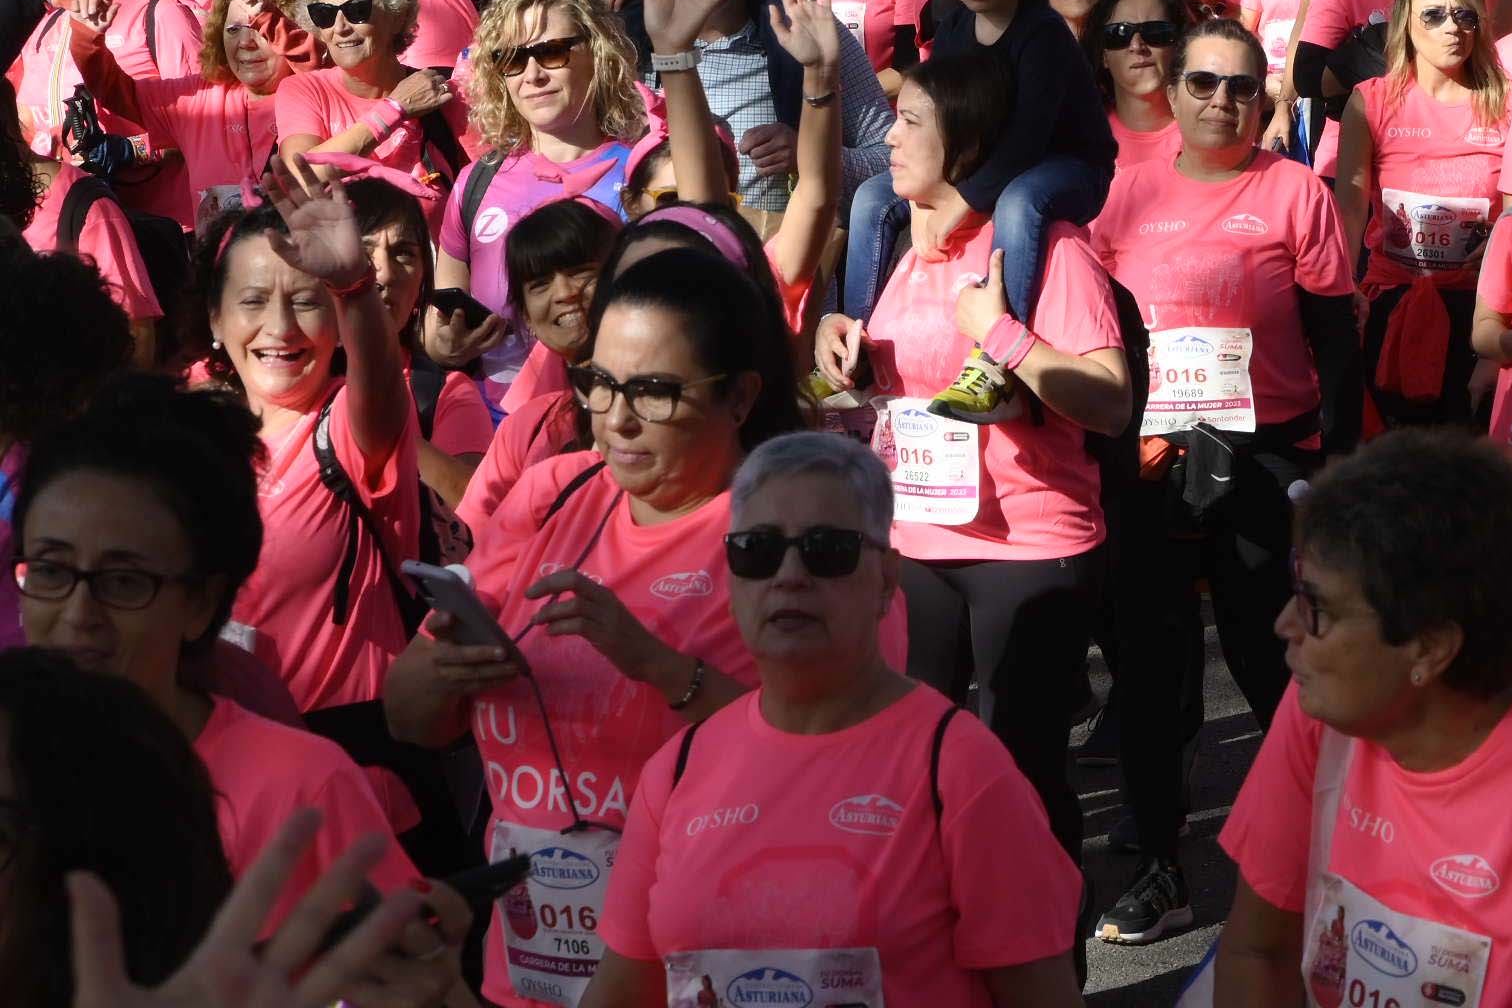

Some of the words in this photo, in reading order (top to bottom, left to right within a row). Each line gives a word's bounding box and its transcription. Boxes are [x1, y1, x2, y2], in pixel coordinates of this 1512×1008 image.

[1388, 127, 1432, 139] OYSHO
[1140, 220, 1187, 234] OYSHO
[1415, 231, 1450, 246] 016
[1417, 248, 1445, 258] 26301
[1166, 368, 1208, 383] 016
[1188, 402, 1198, 410] LA
[900, 447, 934, 465] 016
[905, 470, 930, 482] 26522
[475, 702, 517, 744] TU
[835, 807, 899, 827] ASTURIAN
[531, 861, 594, 881] ASTURIANA
[540, 904, 598, 932] 016
[553, 937, 591, 955] 7106
[1356, 931, 1409, 973] ASTURIANA
[520, 953, 558, 970] CARRERA
[559, 957, 572, 972] DE
[572, 959, 586, 973] LA
[1428, 954, 1471, 975] SUMA
[521, 977, 562, 998] OYSHO
[821, 977, 865, 990] SUMA
[733, 985, 807, 1005] ASTURIANA
